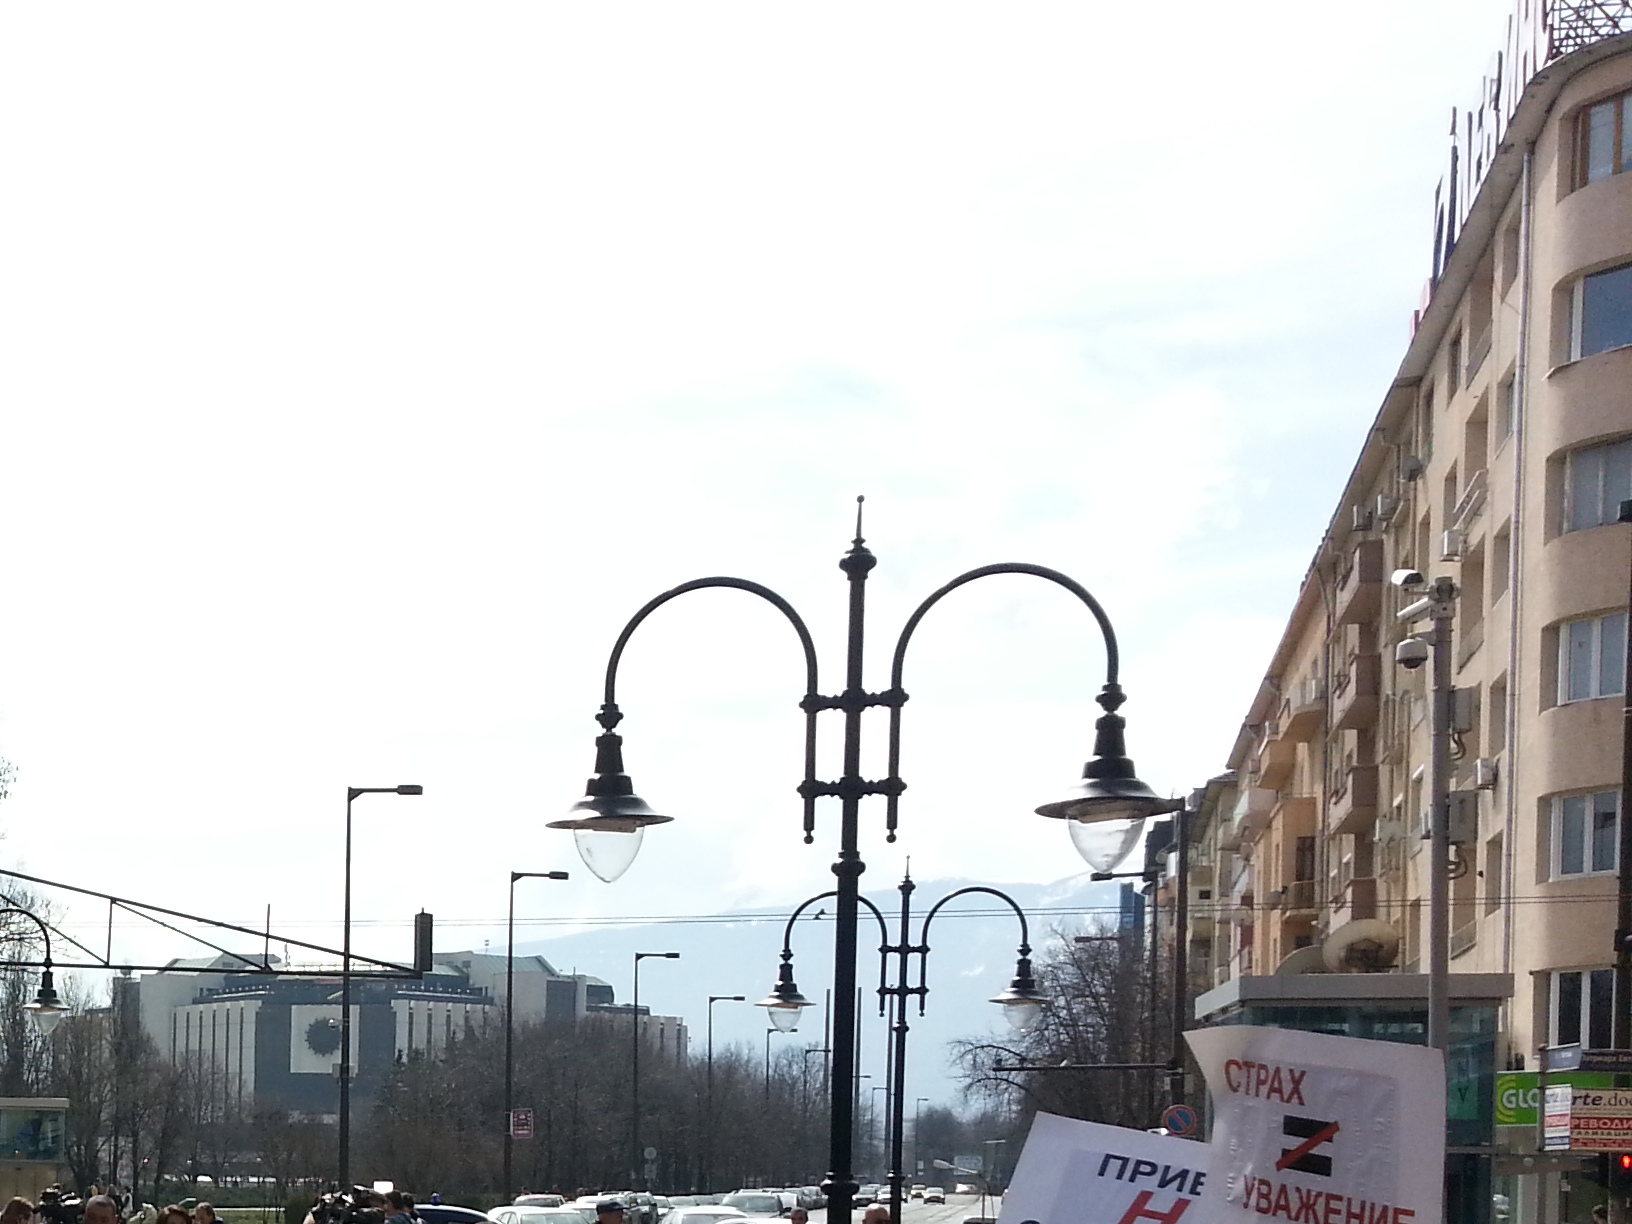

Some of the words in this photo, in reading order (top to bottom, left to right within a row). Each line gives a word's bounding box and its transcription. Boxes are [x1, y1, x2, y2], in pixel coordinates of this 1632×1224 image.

[1224, 1058, 1307, 1107] СТРАХ
[1502, 1089, 1540, 1109] GLO
[1097, 1152, 1207, 1197] ПРИЕ
